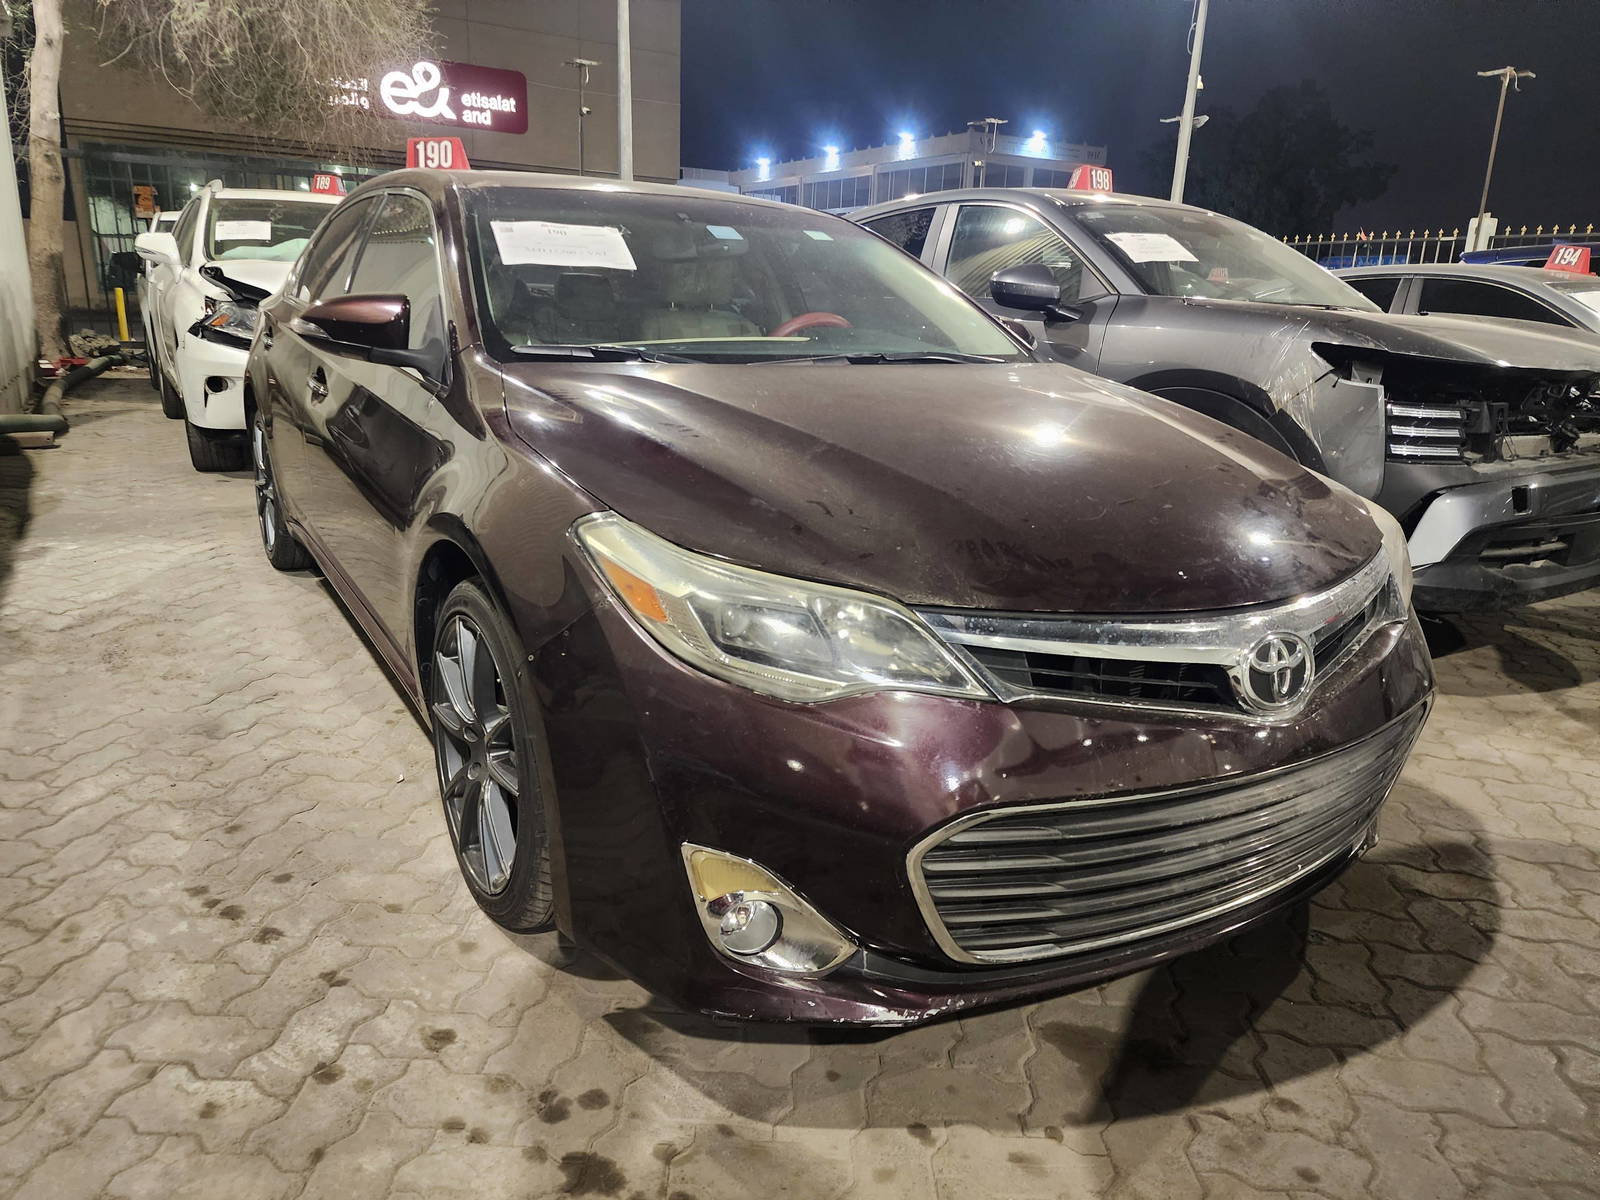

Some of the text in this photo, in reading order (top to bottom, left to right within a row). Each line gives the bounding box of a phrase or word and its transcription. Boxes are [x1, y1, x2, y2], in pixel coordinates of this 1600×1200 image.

[461, 92, 516, 113] etisalat
[462, 109, 492, 125] and
[416, 140, 453, 169] 190
[316, 176, 331, 190] 189
[1092, 169, 1109, 190] 198
[1555, 248, 1582, 266] 194
